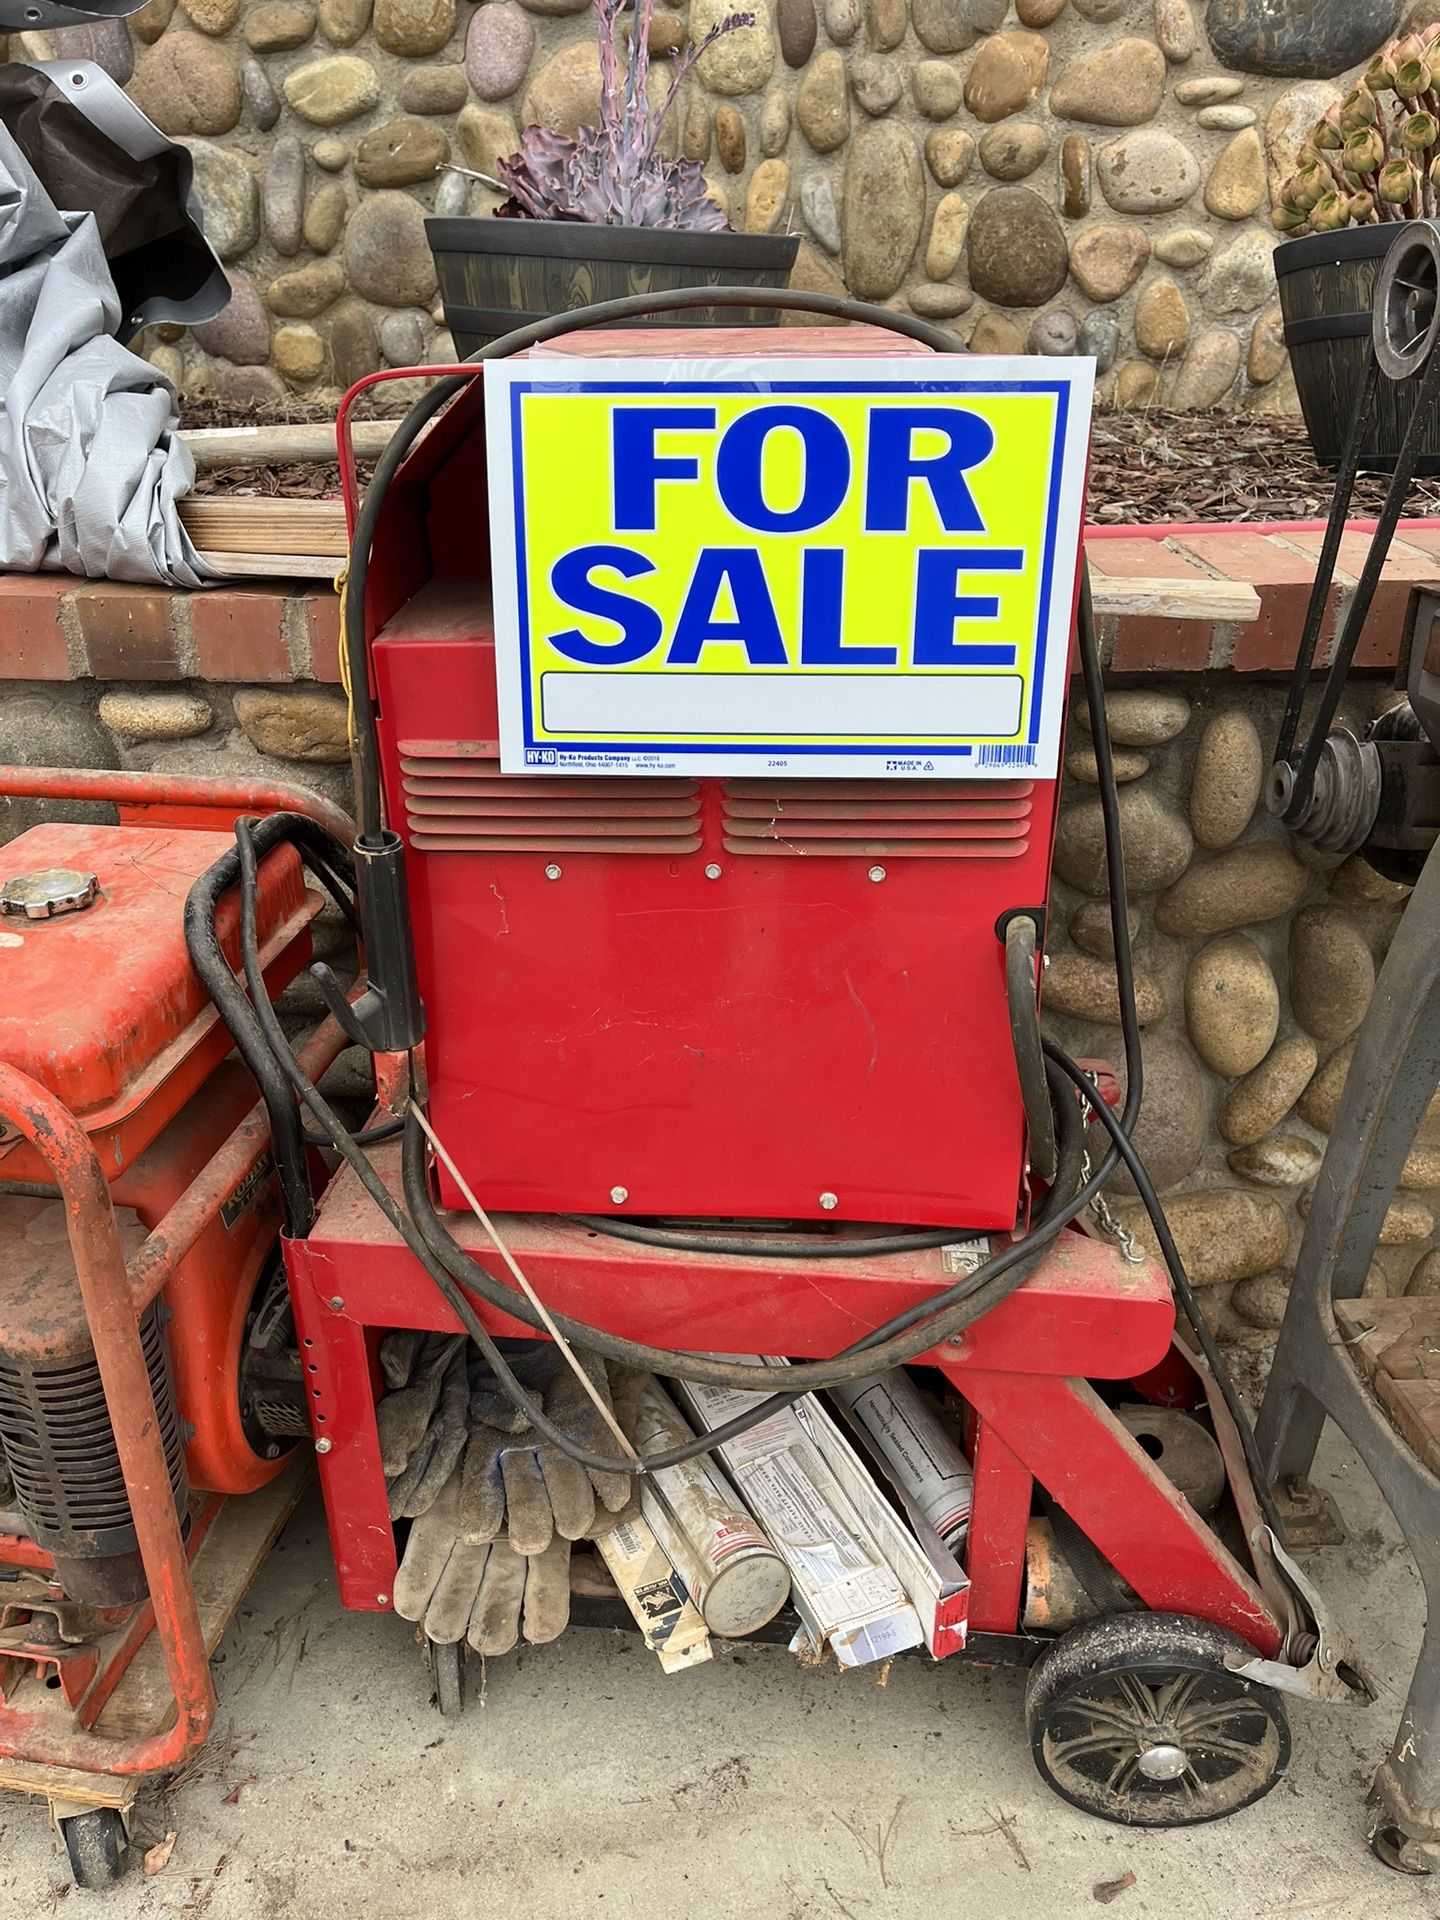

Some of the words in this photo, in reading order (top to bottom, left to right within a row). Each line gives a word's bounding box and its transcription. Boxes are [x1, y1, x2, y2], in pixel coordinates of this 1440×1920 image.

[613, 404, 995, 535] FOR
[546, 544, 1024, 666] SALE
[527, 750, 555, 764] HY-KO
[559, 754, 576, 762] Hy-Ko
[577, 754, 603, 762] Products
[604, 754, 631, 763] Company
[867, 1399, 893, 1434] Hermetically
[888, 1431, 905, 1453] Sealed
[901, 1451, 925, 1483] Containers
